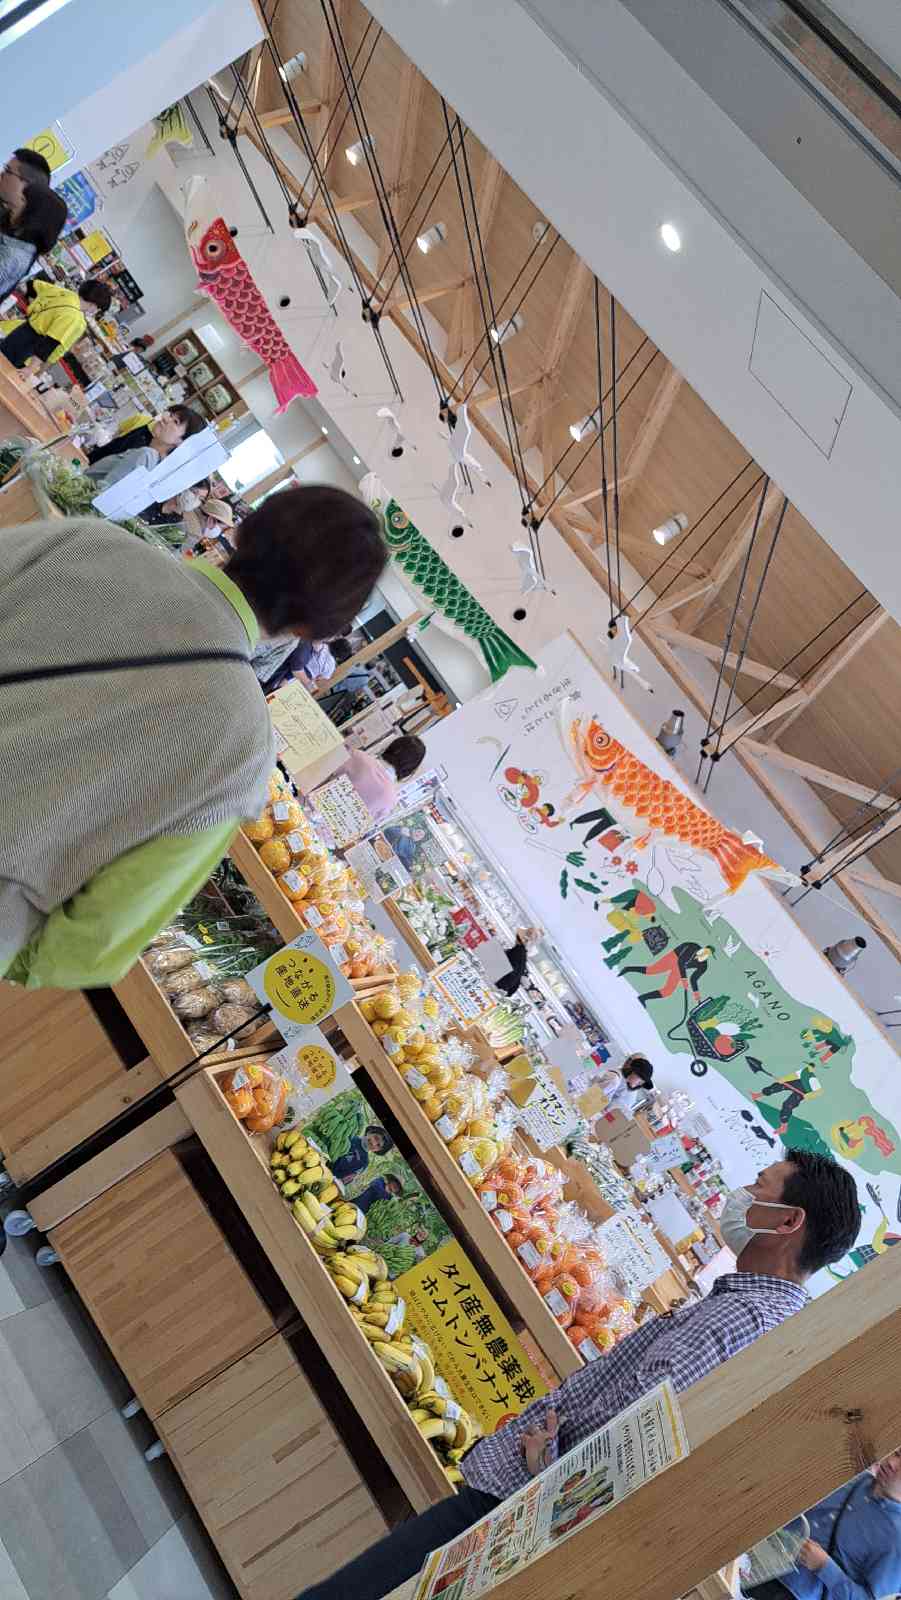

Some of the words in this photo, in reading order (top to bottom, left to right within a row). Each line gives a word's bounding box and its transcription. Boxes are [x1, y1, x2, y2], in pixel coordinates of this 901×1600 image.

[275, 965, 310, 1010] 産地直送
[287, 958, 319, 1004] つながる
[744, 969, 791, 1022] AGANO
[420, 1275, 511, 1409] ホムトンバナナ
[438, 1263, 536, 1405] タイ産無農薬栽
